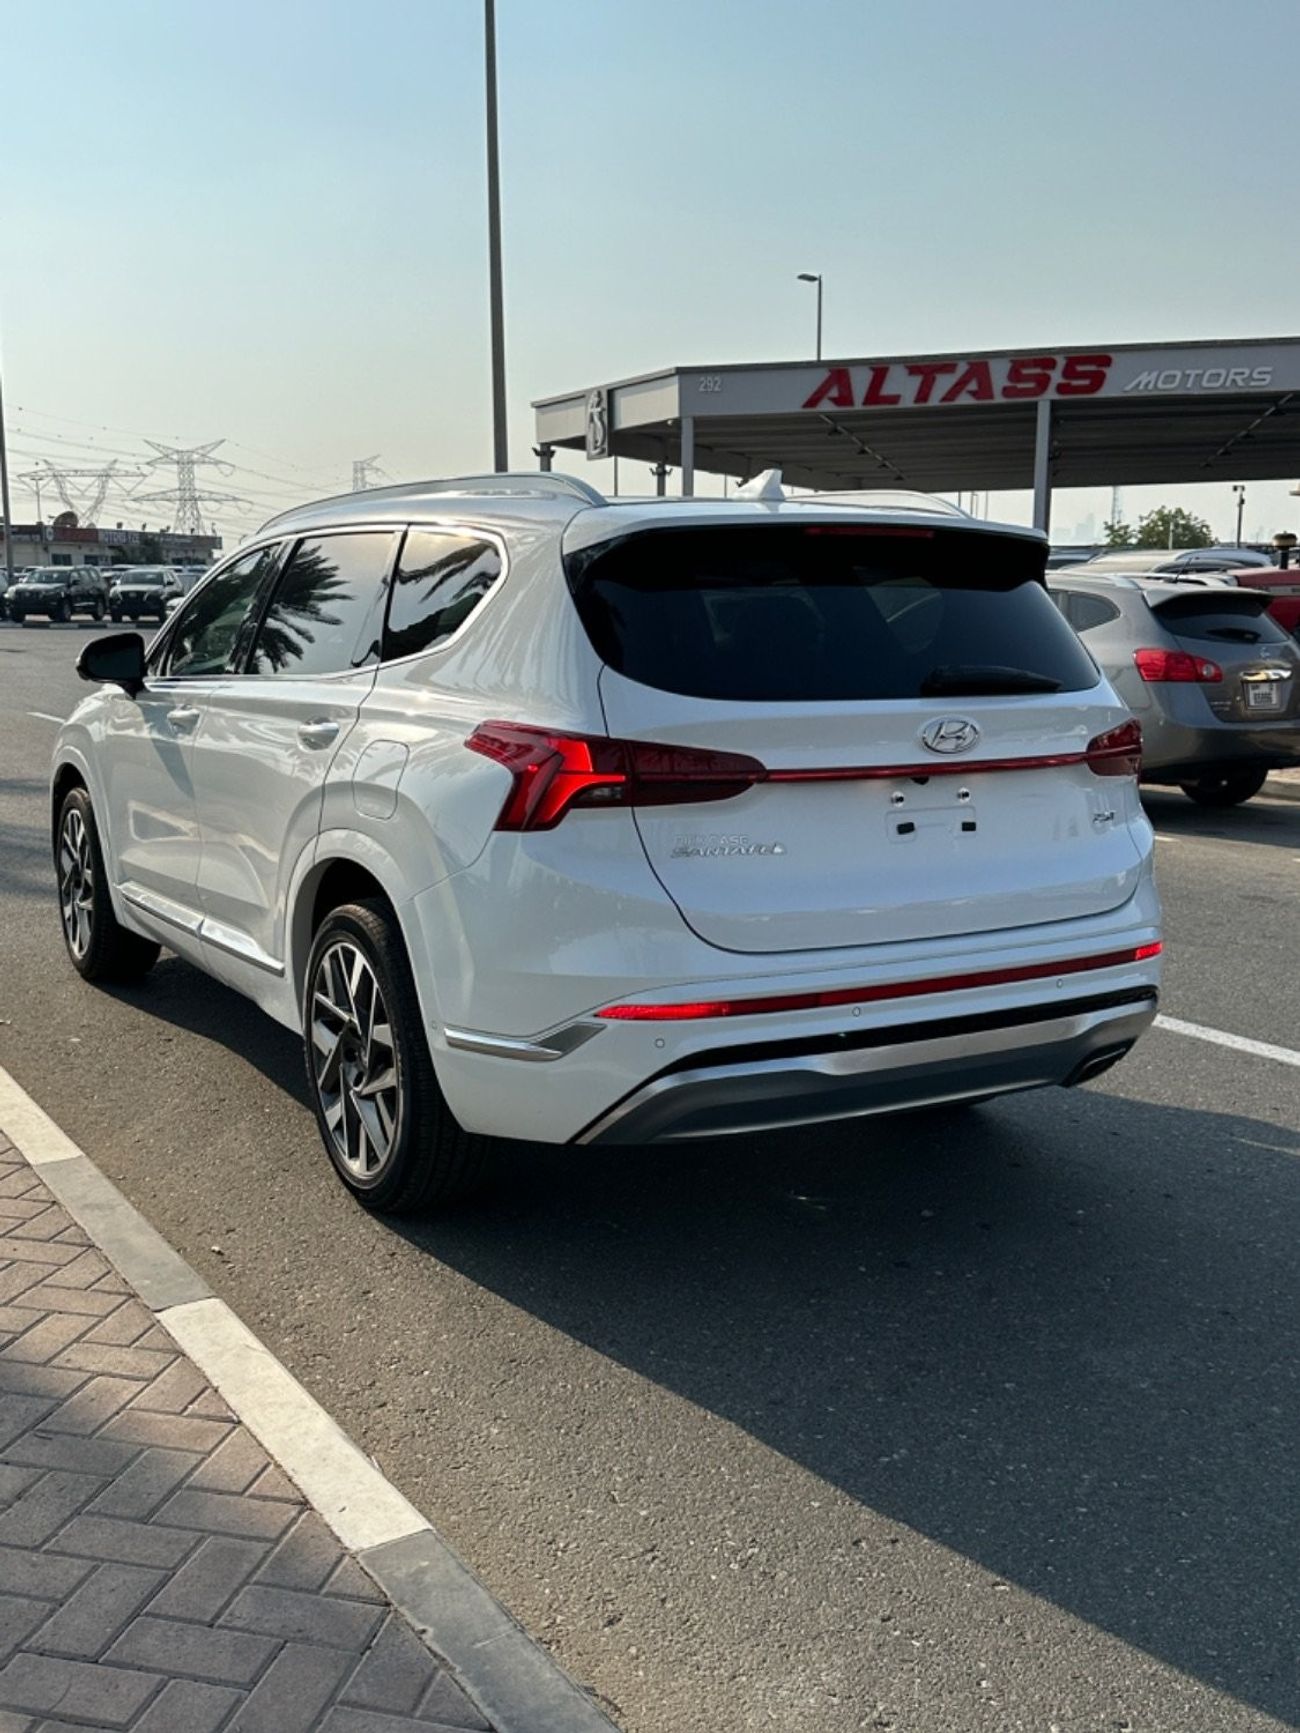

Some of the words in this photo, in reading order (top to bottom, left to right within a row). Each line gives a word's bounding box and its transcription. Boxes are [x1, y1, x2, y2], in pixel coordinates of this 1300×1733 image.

[698, 375, 722, 393] 292
[801, 354, 1112, 410] ALTASS
[1122, 366, 1275, 393] MOTORS
